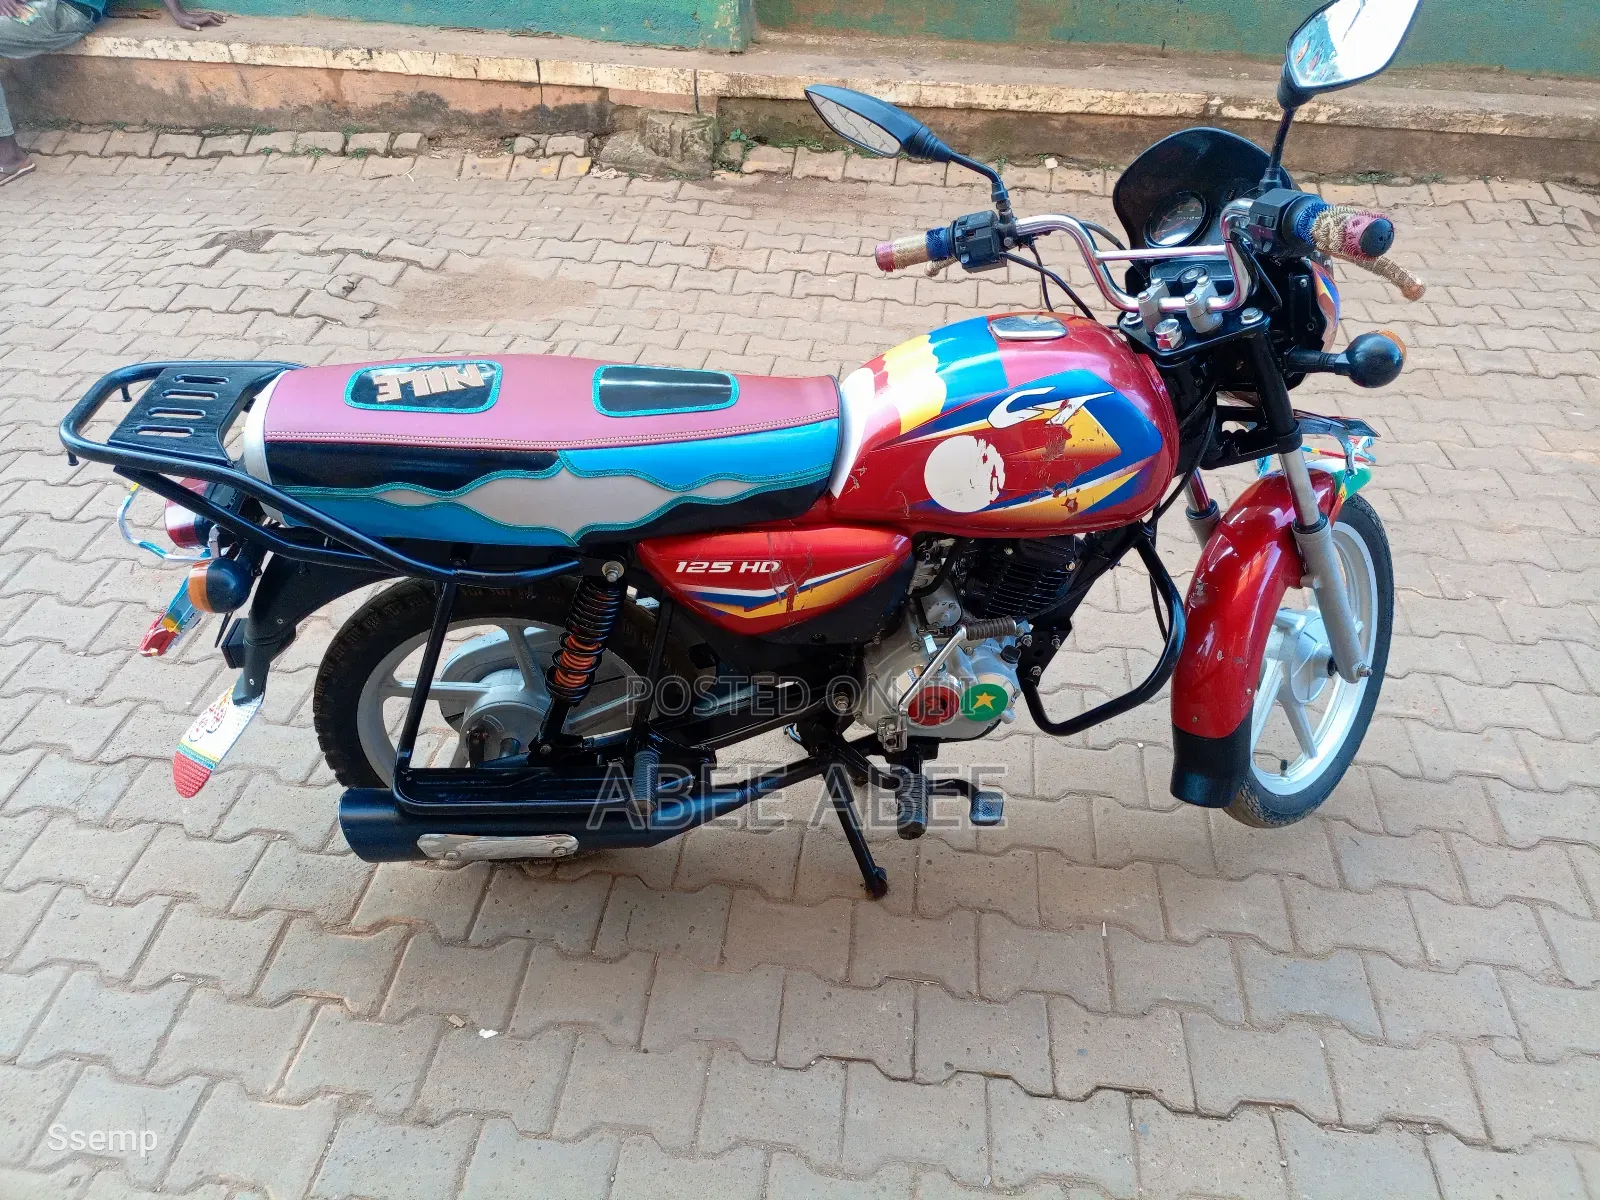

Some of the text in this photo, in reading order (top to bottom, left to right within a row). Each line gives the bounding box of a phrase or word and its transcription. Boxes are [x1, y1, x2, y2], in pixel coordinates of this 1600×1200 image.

[373, 363, 486, 403] NILE
[675, 561, 781, 573] 125 HD
